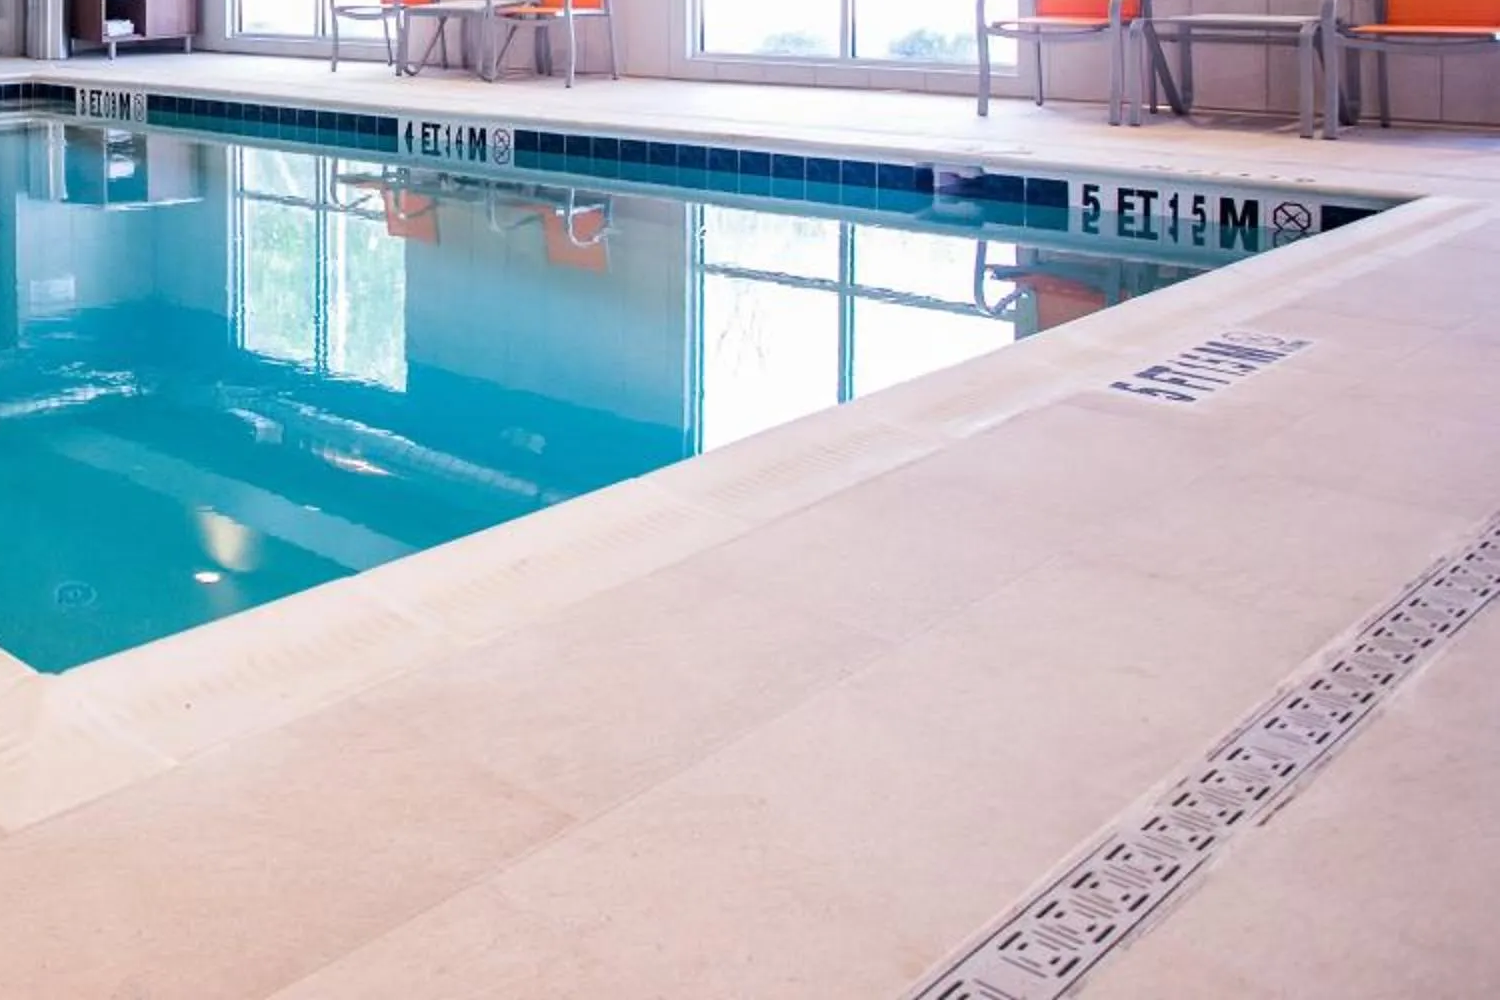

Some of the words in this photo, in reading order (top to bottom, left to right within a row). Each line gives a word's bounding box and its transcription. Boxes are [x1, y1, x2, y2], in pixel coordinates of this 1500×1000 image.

[1082, 183, 1099, 213] 5
[1220, 197, 1259, 232] M
[1192, 341, 1287, 364] M
[1134, 365, 1231, 392] FT
[1109, 381, 1197, 402] 5
